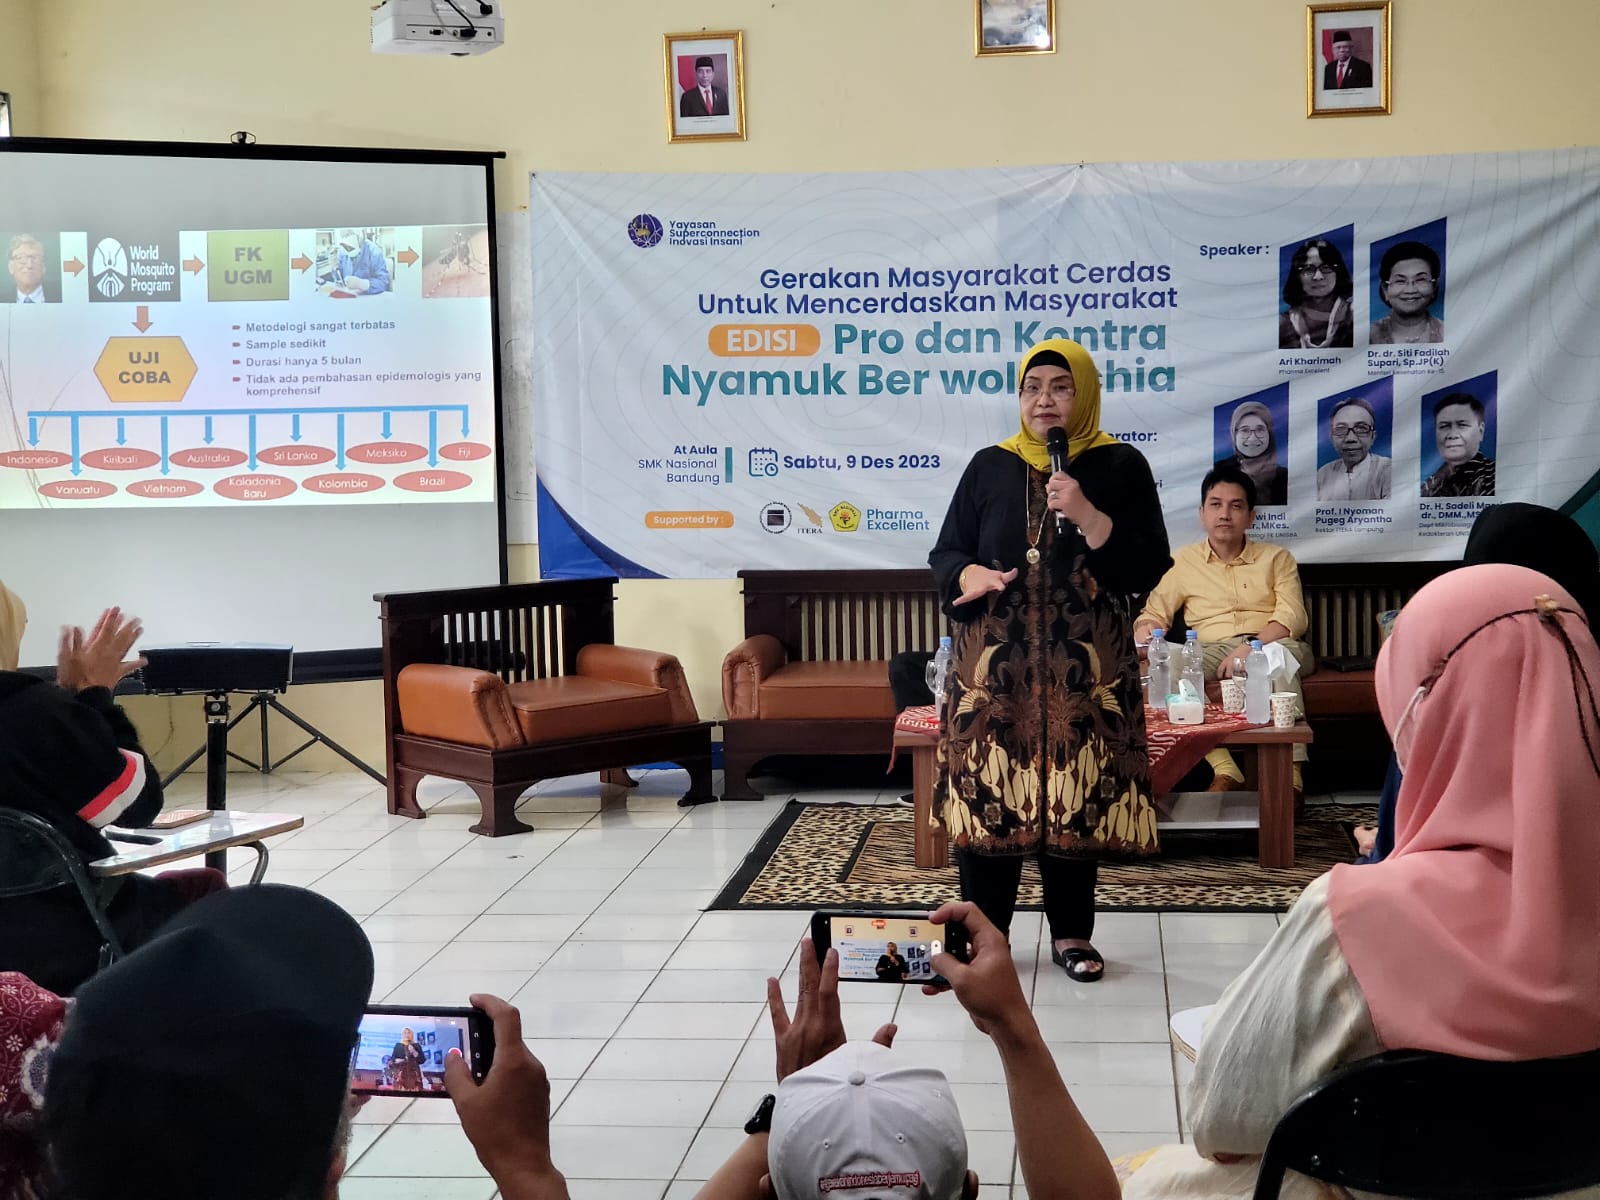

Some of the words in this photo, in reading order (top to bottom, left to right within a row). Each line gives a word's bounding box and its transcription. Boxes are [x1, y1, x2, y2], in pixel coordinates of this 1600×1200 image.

[669, 220, 716, 230] Yayasan
[669, 228, 760, 239] Superconnection
[669, 237, 708, 246] Inovasi
[710, 236, 743, 246] Insani
[130, 245, 159, 261] World
[234, 247, 263, 262] FK
[130, 262, 175, 281] Mosquito
[224, 269, 272, 285] UGM
[760, 267, 879, 289] Gerakan
[888, 263, 1059, 294] Masyarakat
[1067, 261, 1171, 284] Cerdas
[130, 278, 171, 295] Program
[698, 293, 778, 315] Untuk
[786, 290, 996, 315] Mencerdaskan
[1004, 287, 1178, 318] Masyarakat
[246, 322, 307, 333] Metodelogi
[310, 321, 348, 332] sangat
[350, 319, 396, 330] terbatas
[727, 329, 796, 352] EDISI
[834, 323, 904, 355] Pro
[915, 321, 1001, 355] dan
[246, 339, 287, 350] Sample
[290, 338, 327, 349] sedikit
[128, 351, 160, 364] UJI
[1367, 350, 1381, 358] Dr.
[1382, 349, 1396, 357] dr.
[1398, 349, 1413, 357] Siti
[1414, 348, 1450, 357] Fadilah
[246, 357, 282, 367] Durasi
[285, 356, 318, 367] hanya
[321, 356, 329, 366] 5
[331, 356, 362, 366] bulan
[1279, 357, 1293, 366] Ari
[1294, 356, 1341, 366] Kharimah
[1367, 358, 1401, 367] Supari,
[118, 371, 171, 384] COBA
[246, 374, 276, 384] Tidak
[279, 373, 299, 384] ada
[301, 371, 372, 384] pembahasan
[376, 370, 451, 383] epidemologis
[454, 371, 481, 383] yang
[662, 362, 848, 407] Nyamuk
[858, 363, 930, 396] Ber
[940, 356, 1176, 395] wolhia
[246, 385, 321, 397] komprehensif
[1109, 431, 1157, 442] rator:
[366, 448, 407, 458] Meksiko
[458, 447, 471, 457] Fiji
[674, 445, 688, 455] At
[689, 444, 718, 455] Aula
[7, 455, 59, 465] Indonesia
[187, 454, 231, 464] Australia
[274, 450, 285, 461] Sri
[287, 450, 318, 461] Lanka
[638, 459, 662, 469] SMK
[666, 459, 717, 469] Nasional
[783, 455, 842, 471] Sabtu,
[846, 455, 856, 468] 9
[861, 455, 894, 468] Des
[898, 454, 941, 468] 2023
[318, 478, 369, 489] Kolombia
[419, 476, 446, 487] Brazil
[667, 473, 720, 485] Bandung
[55, 485, 100, 495] Vanuatu
[143, 484, 187, 494] Vietnam
[243, 488, 267, 499] Baru
[1419, 503, 1433, 511] Dr.
[1445, 501, 1475, 510] Sadeli
[866, 508, 923, 520] Pharma
[1315, 507, 1337, 516] Prof.
[1343, 507, 1384, 517] Nyoman
[653, 514, 705, 527] Supported
[706, 514, 719, 525] by
[866, 519, 930, 530] Excellent
[1315, 517, 1346, 526] Pugeg
[1347, 516, 1392, 526] Aryantha
